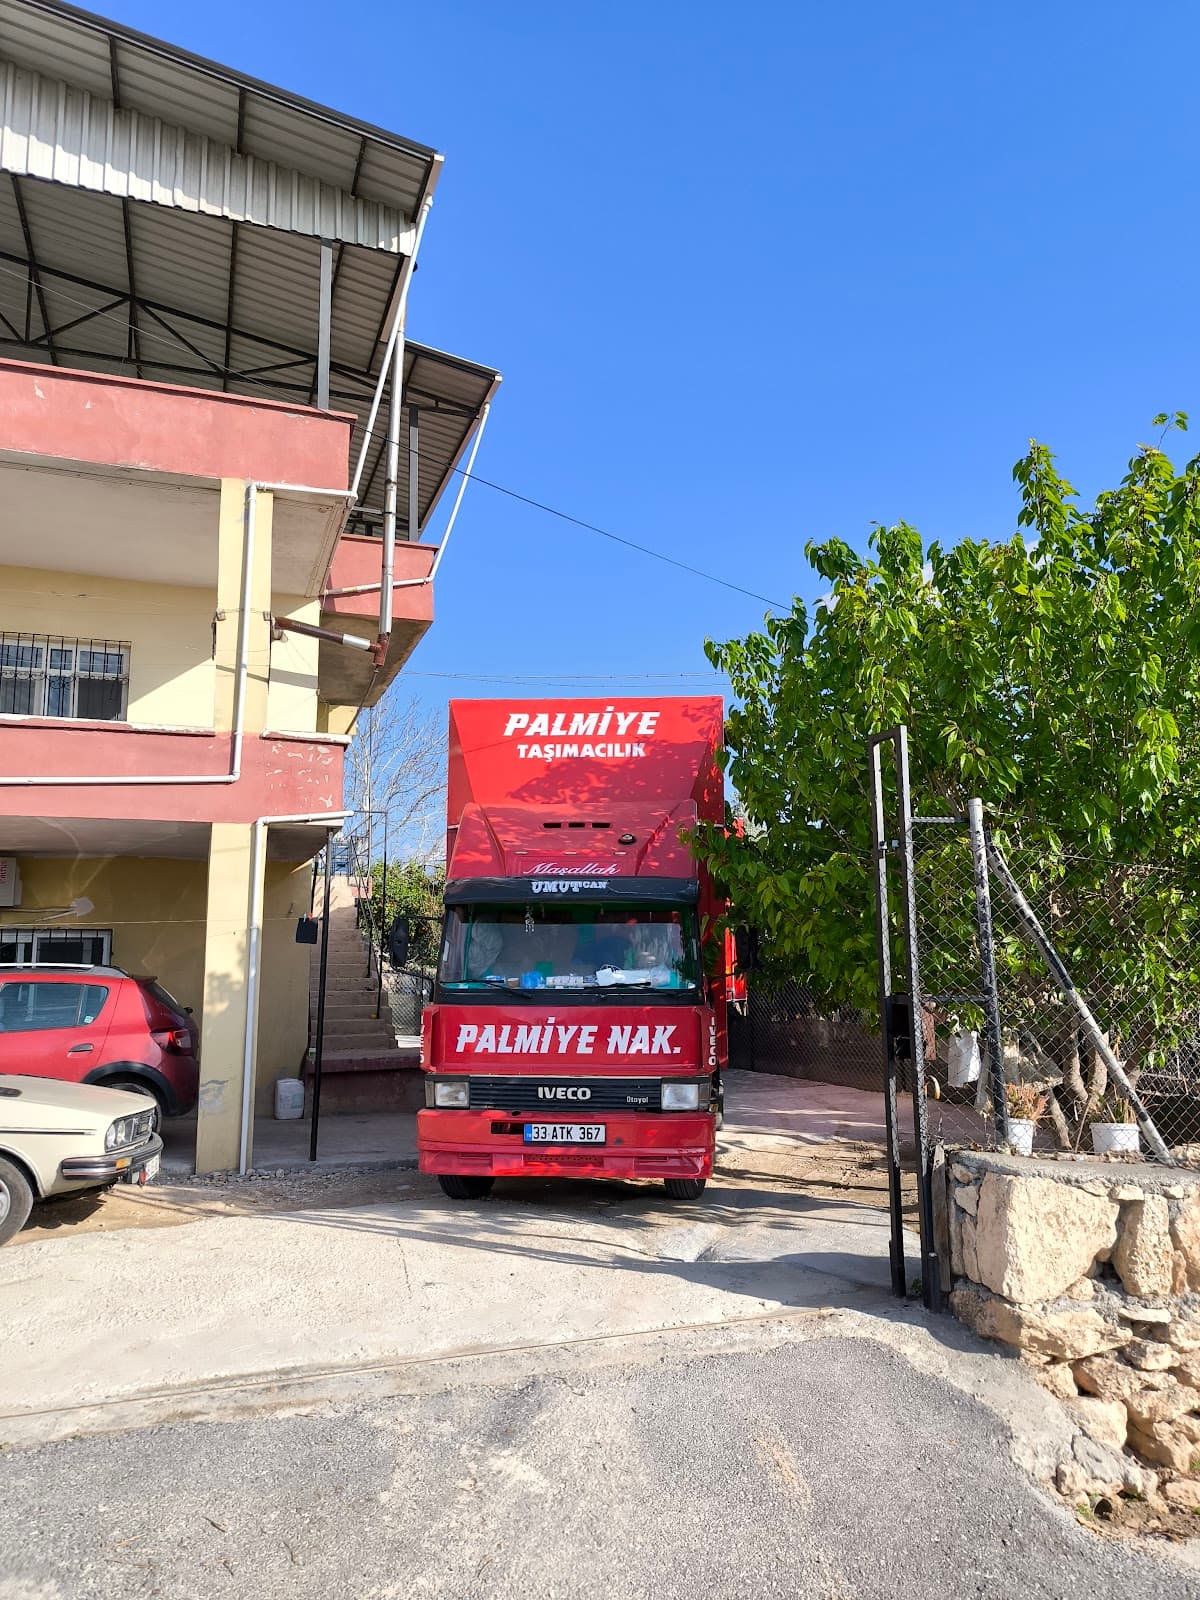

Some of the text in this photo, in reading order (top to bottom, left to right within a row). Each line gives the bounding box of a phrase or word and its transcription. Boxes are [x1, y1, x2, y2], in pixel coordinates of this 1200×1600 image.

[503, 705, 660, 737] PALMİYE
[517, 743, 646, 763] TAŞIMACILIK
[523, 862, 620, 876] Maşallah
[456, 1016, 682, 1055] PALMİYE NAK.
[708, 1016, 717, 1066] IVECO
[537, 1086, 591, 1101] IVECO
[533, 1126, 601, 1141] 33 ATK 367
